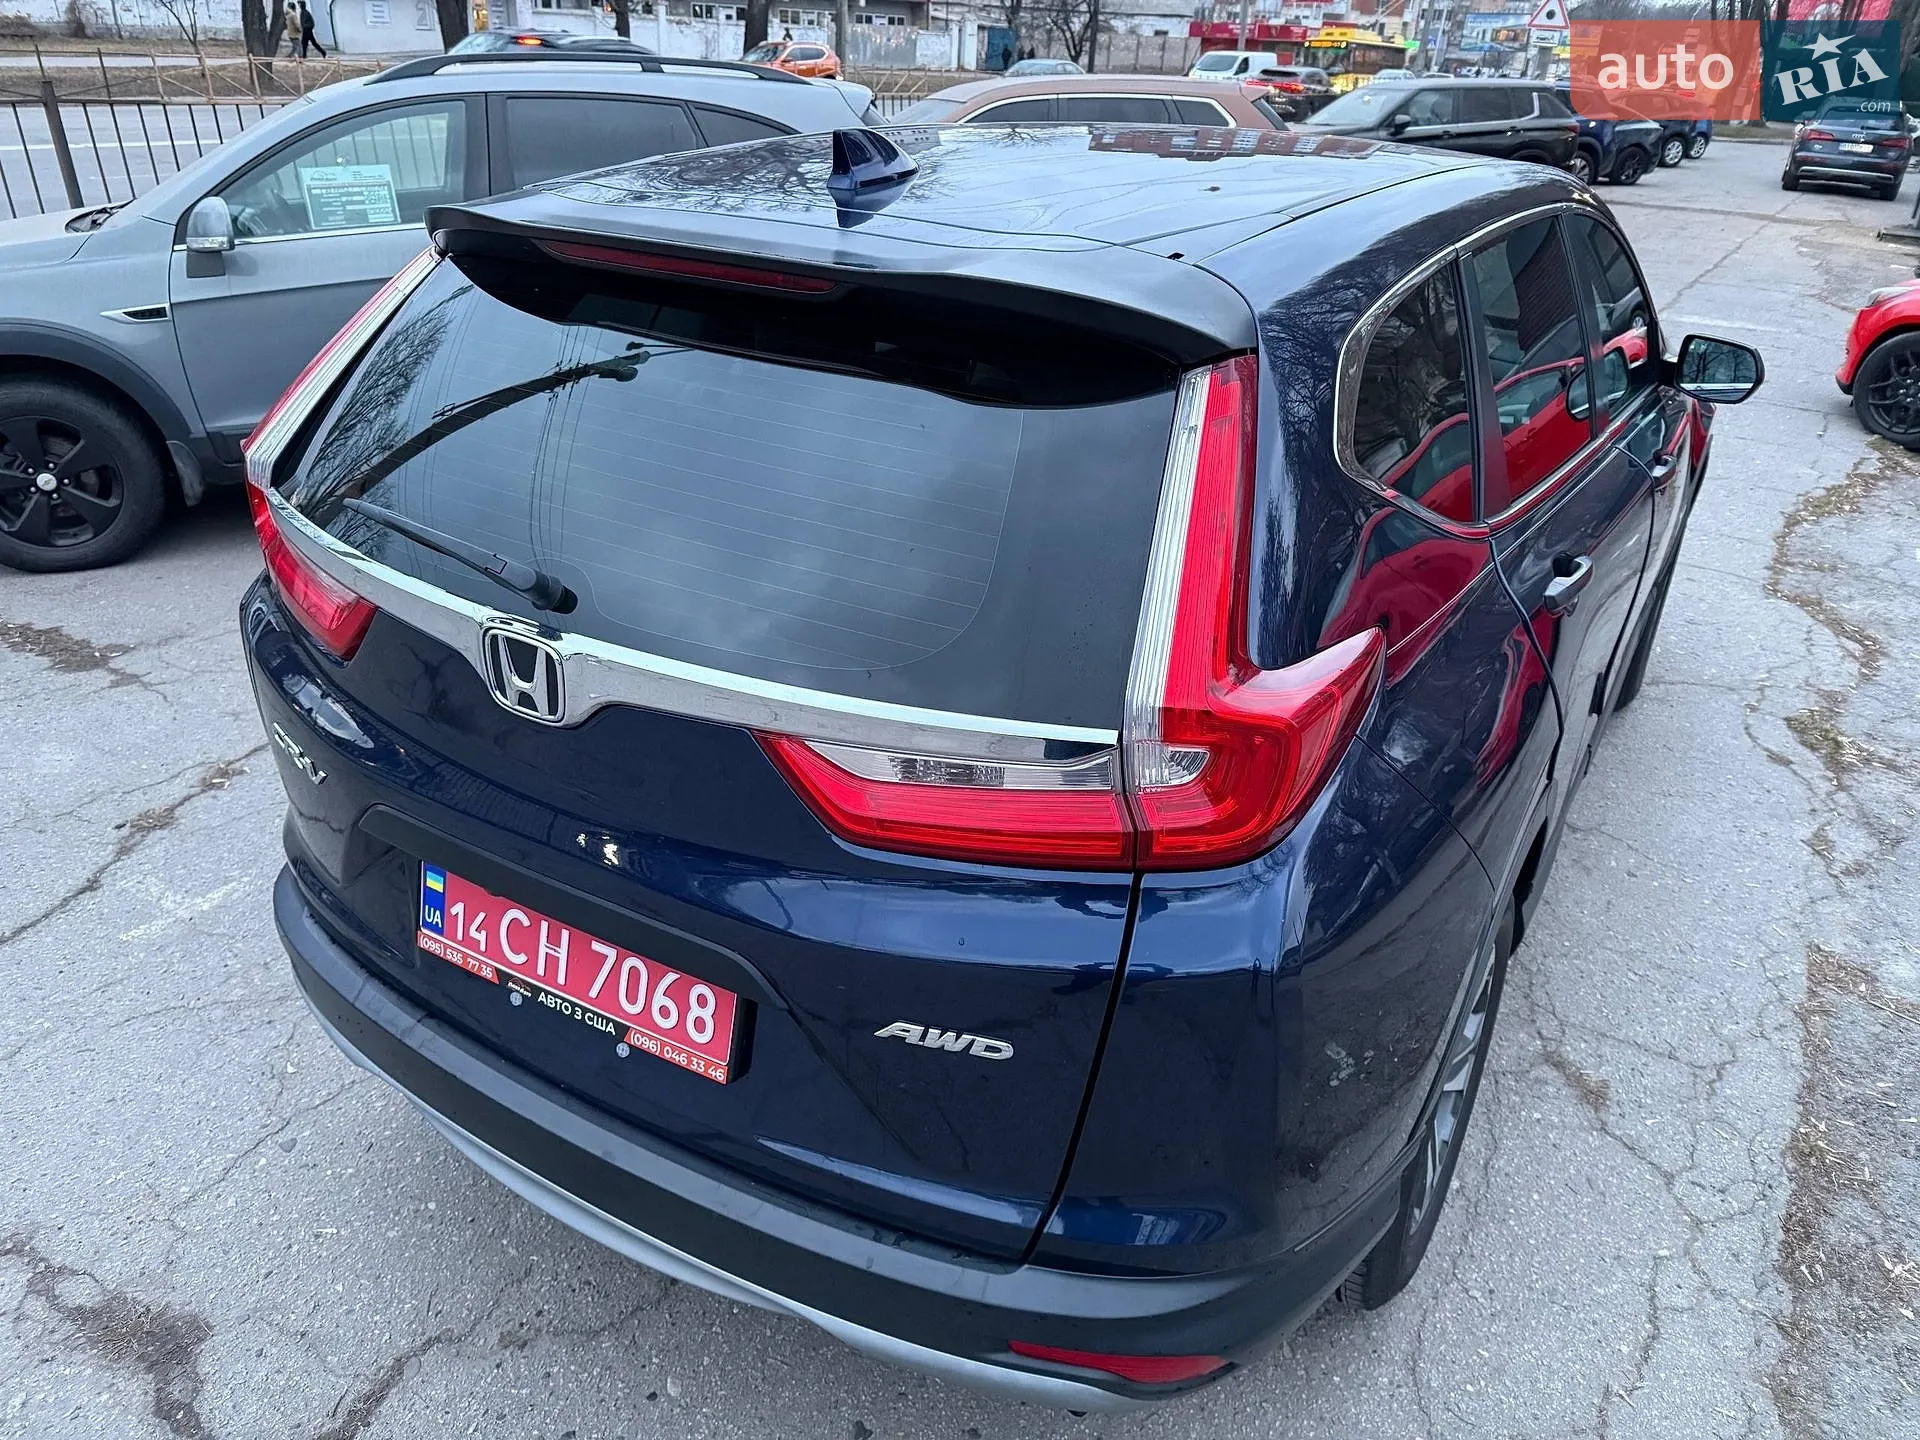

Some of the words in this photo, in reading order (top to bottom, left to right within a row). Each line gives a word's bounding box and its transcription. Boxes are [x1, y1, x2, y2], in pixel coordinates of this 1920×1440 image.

[424, 904, 442, 928] UA
[420, 934, 444, 957] (095)
[446, 949, 463, 965] 535
[467, 957, 479, 972] 77
[480, 963, 493, 978] 35
[538, 991, 572, 1015] АВТО
[585, 1012, 616, 1036] США
[588, 940, 716, 1044] 7068
[630, 1031, 661, 1055] (096)
[663, 1046, 688, 1065] 046
[690, 1056, 705, 1073] 33
[707, 1067, 725, 1081] 46
[873, 1019, 1014, 1060] AWD
